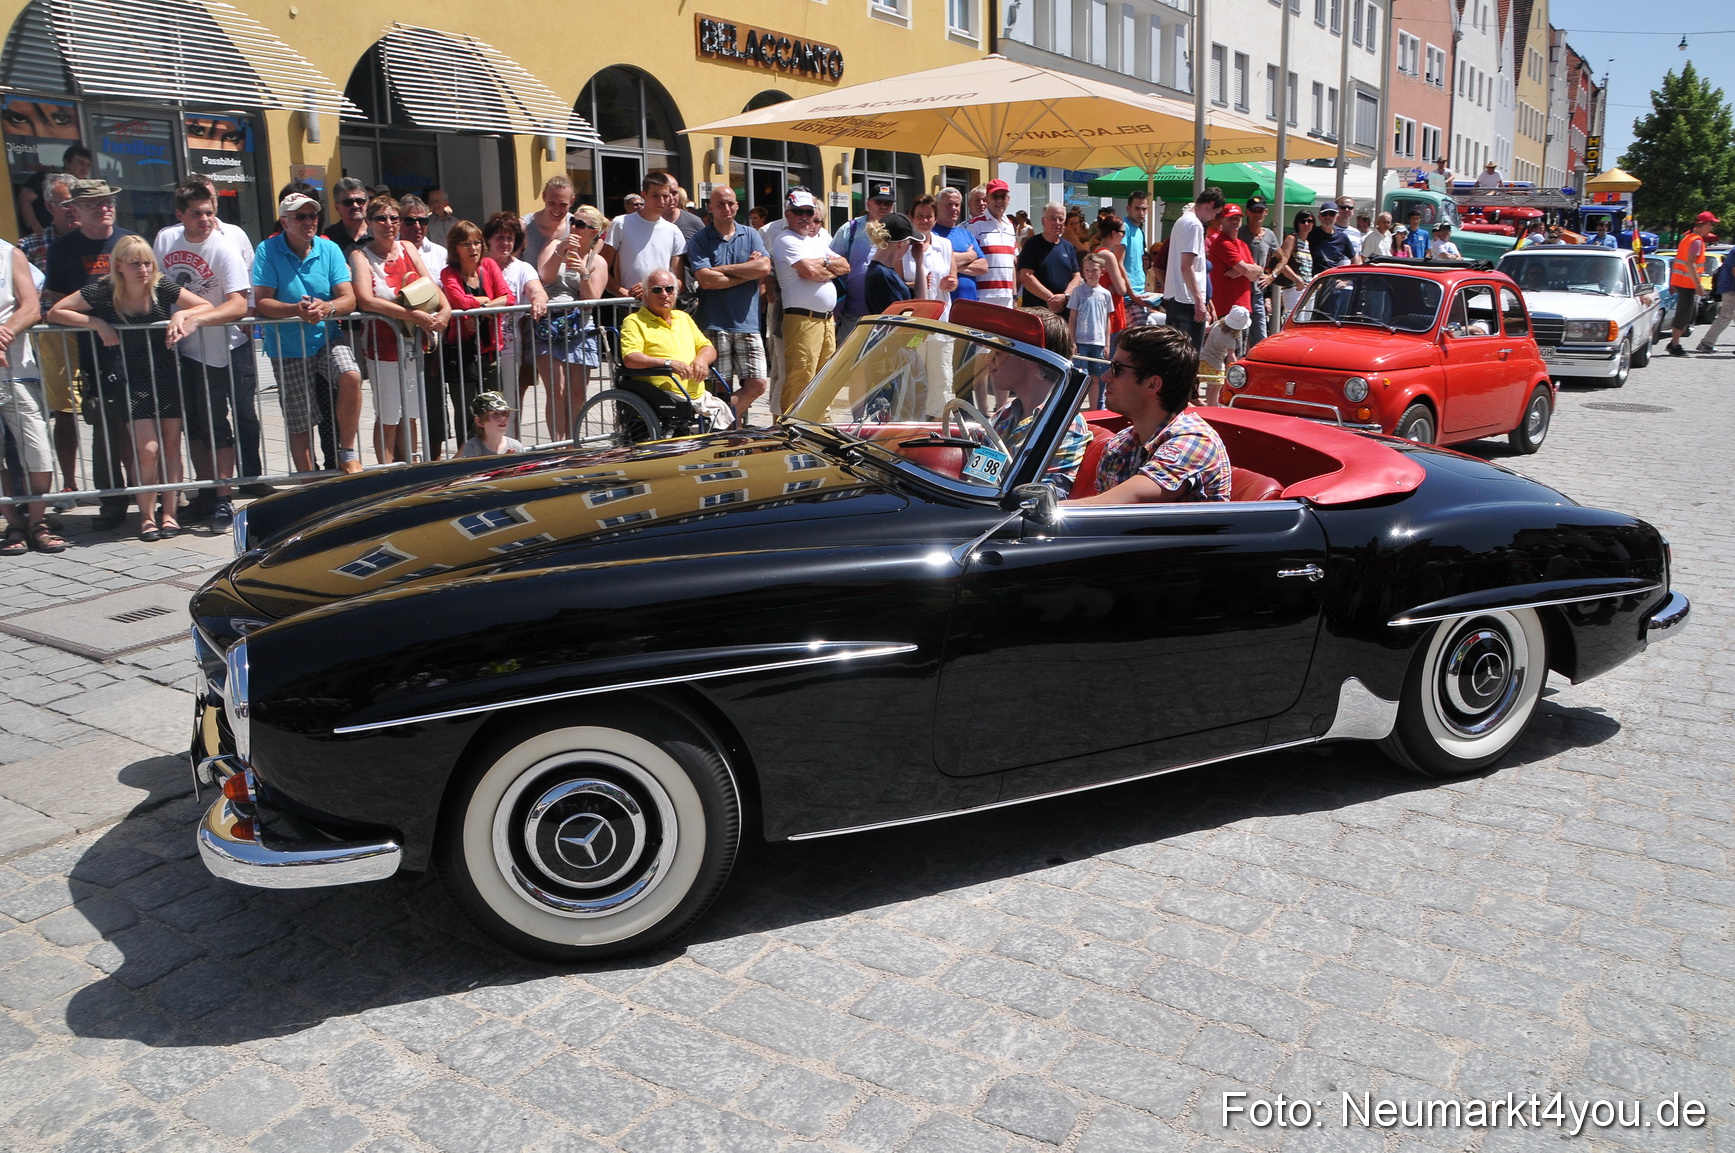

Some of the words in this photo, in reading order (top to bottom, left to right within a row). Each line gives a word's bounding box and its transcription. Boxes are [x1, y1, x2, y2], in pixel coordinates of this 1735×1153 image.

[701, 18, 844, 78] BELACCANTO
[808, 92, 978, 113] BELACCANTO
[202, 156, 241, 167] Passbilder
[1586, 137, 1600, 182] HOT
[217, 189, 237, 197] ofort
[164, 253, 212, 280] VOLBEAT
[971, 455, 981, 468] 3
[984, 459, 1000, 476] 98
